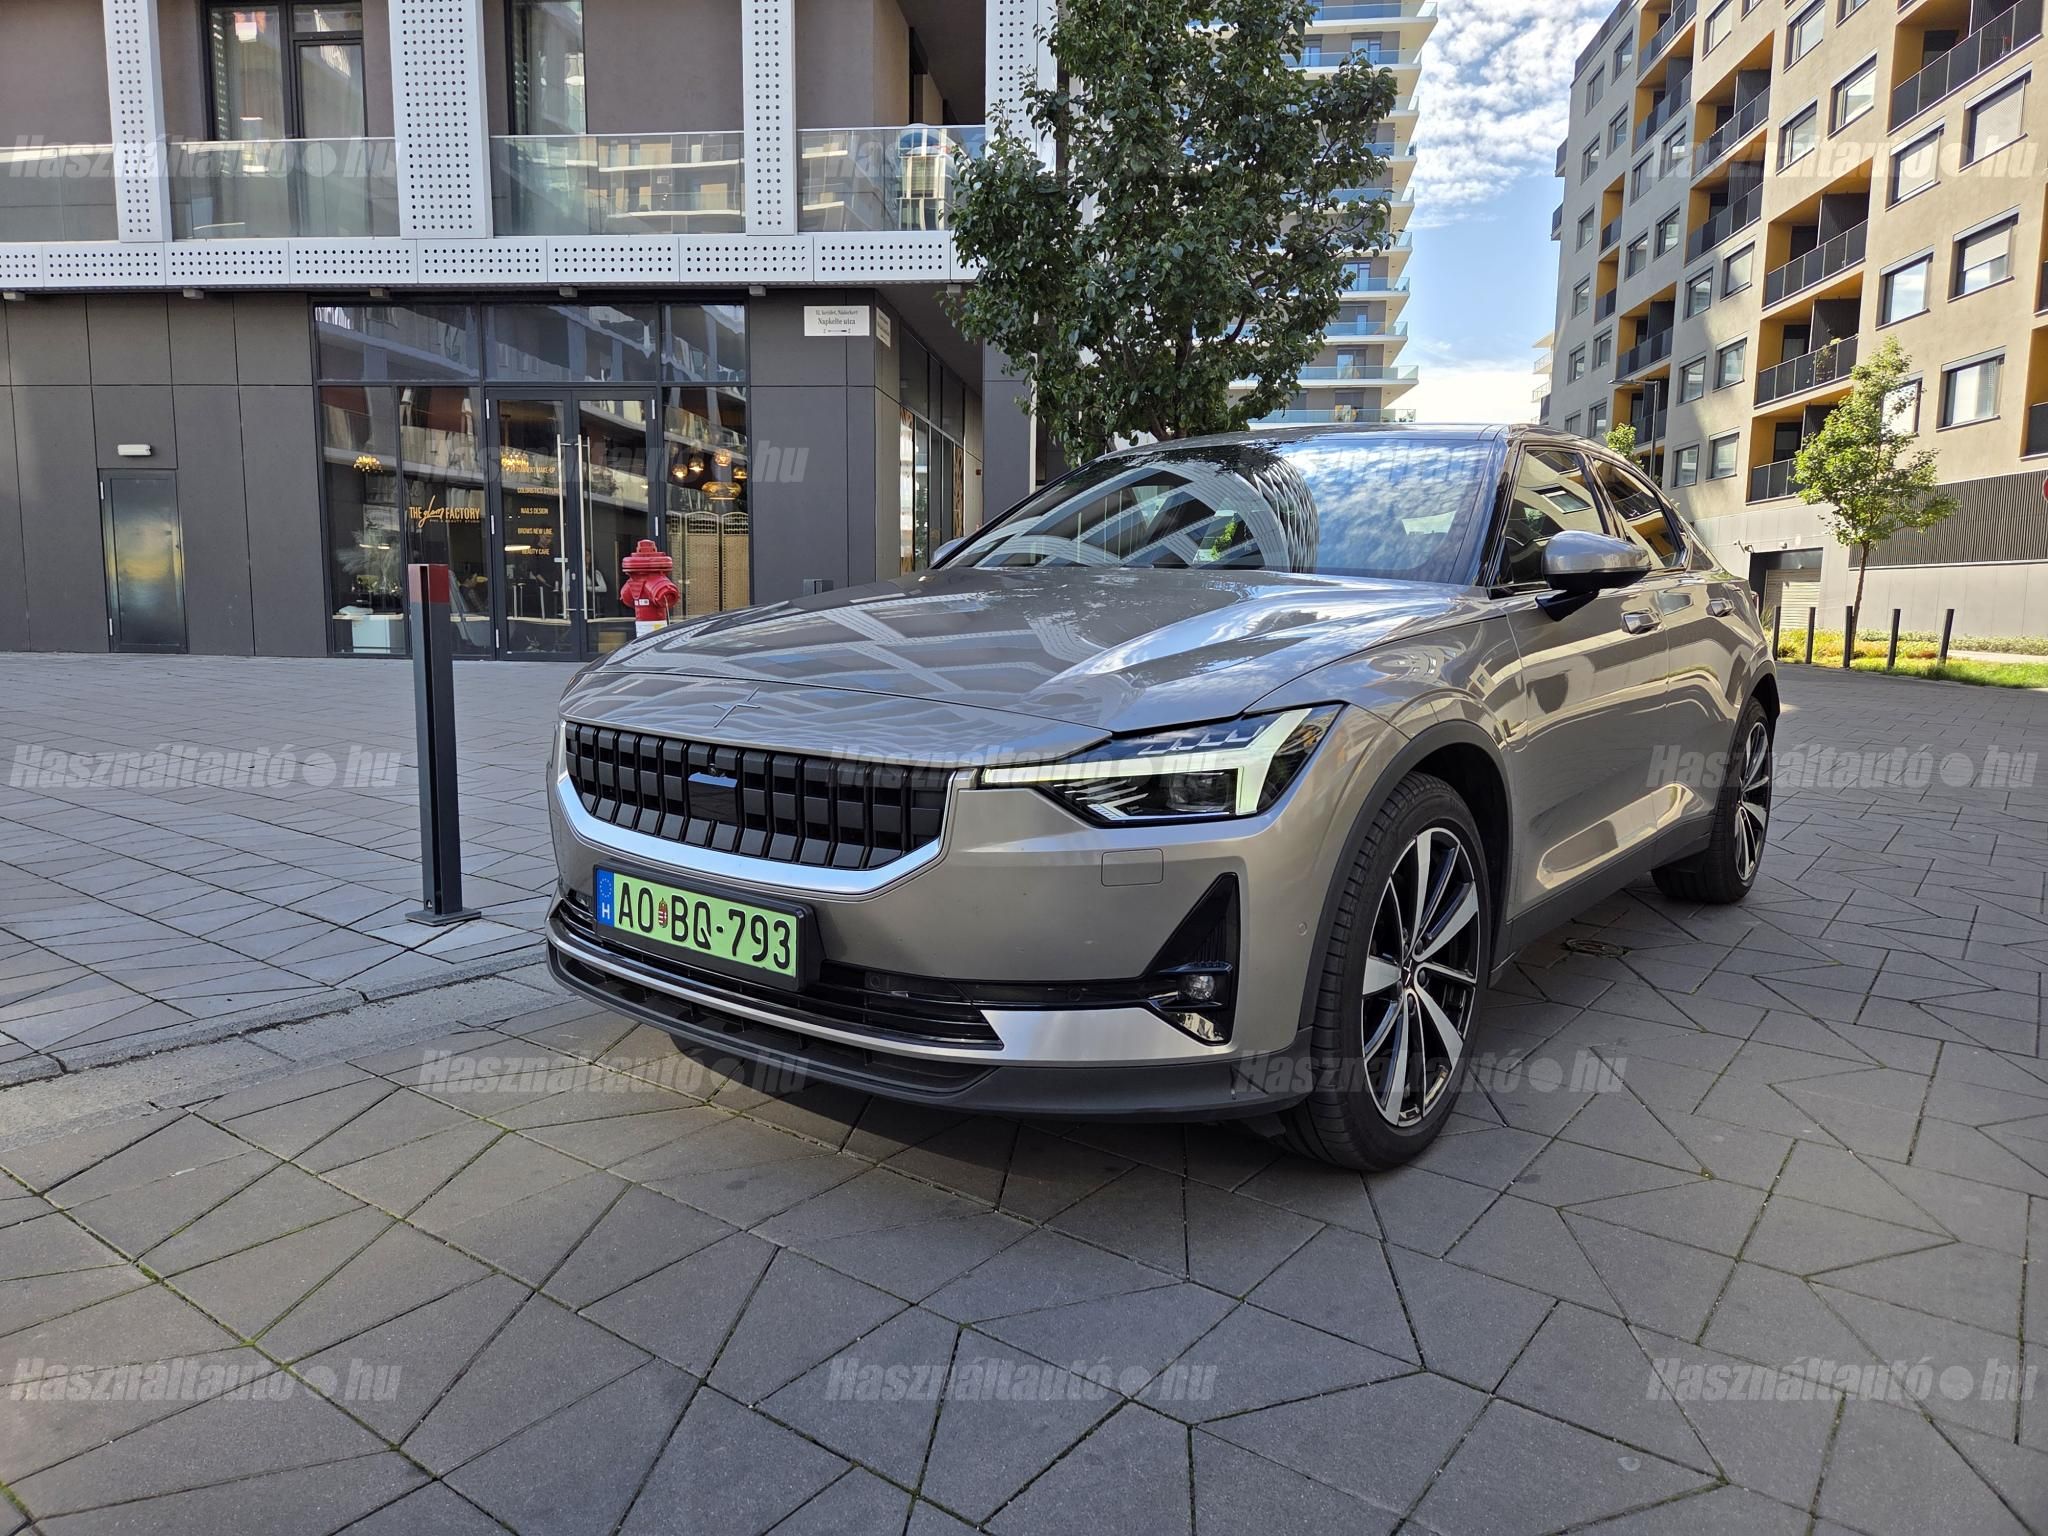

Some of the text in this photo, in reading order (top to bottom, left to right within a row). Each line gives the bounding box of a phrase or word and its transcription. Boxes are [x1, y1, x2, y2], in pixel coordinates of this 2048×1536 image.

[408, 506, 422, 519] THE
[445, 507, 480, 519] FACTORY
[602, 902, 610, 919] H
